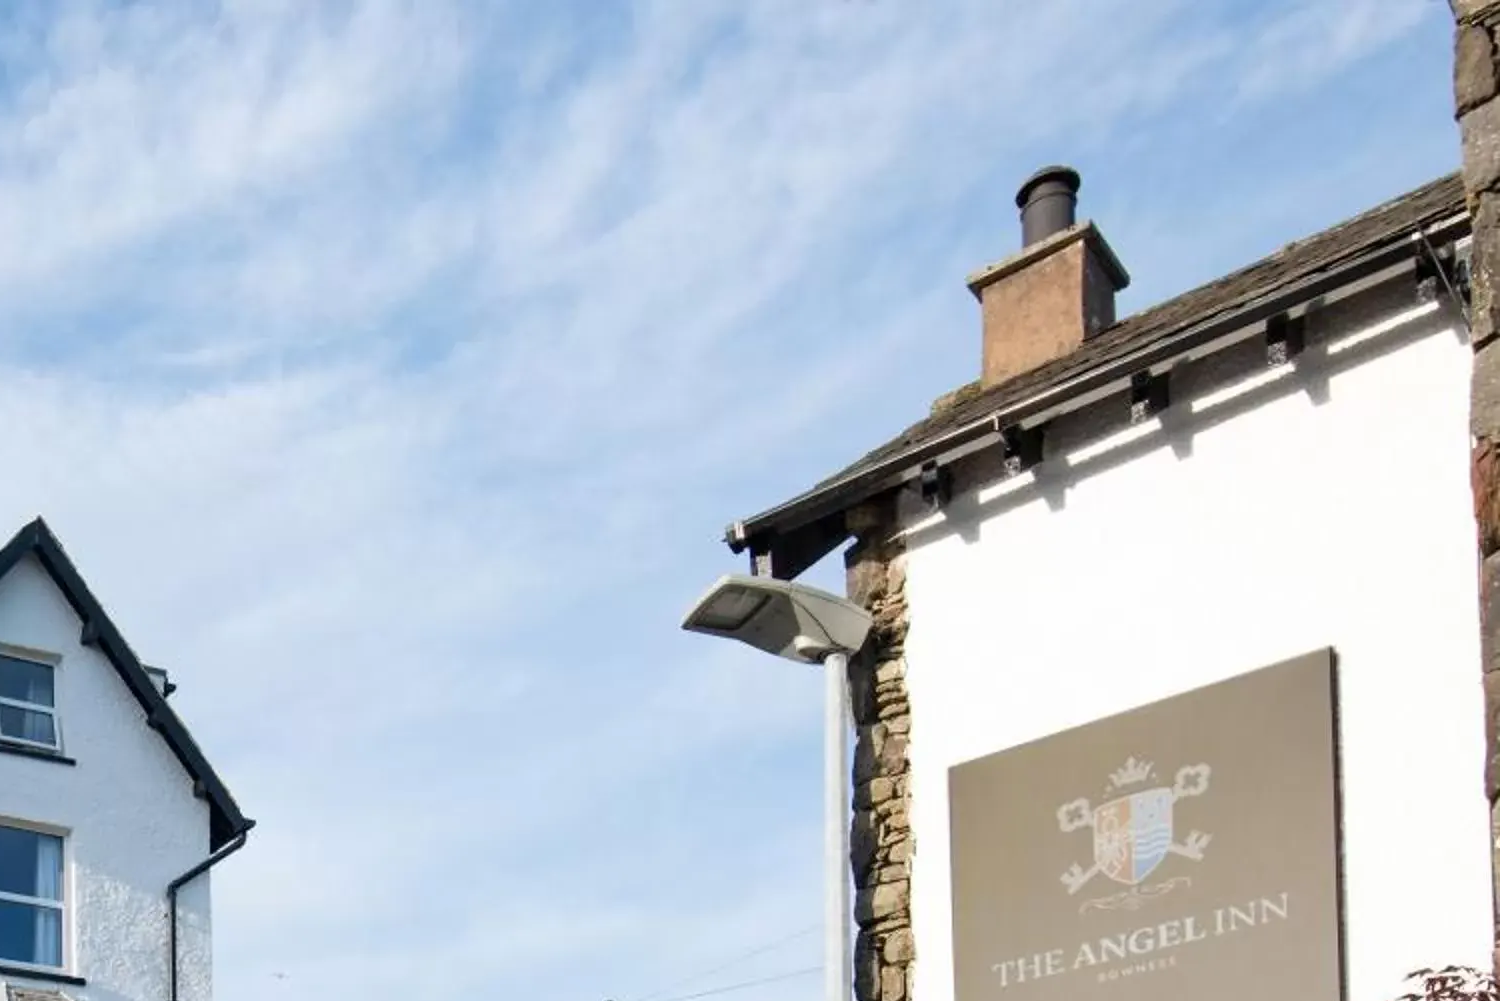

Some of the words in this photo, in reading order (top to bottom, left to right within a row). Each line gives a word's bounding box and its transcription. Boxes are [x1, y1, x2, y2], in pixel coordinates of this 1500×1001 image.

[991, 948, 1065, 987] THE
[1073, 916, 1206, 969] ANGEL
[1214, 892, 1289, 936] INN
